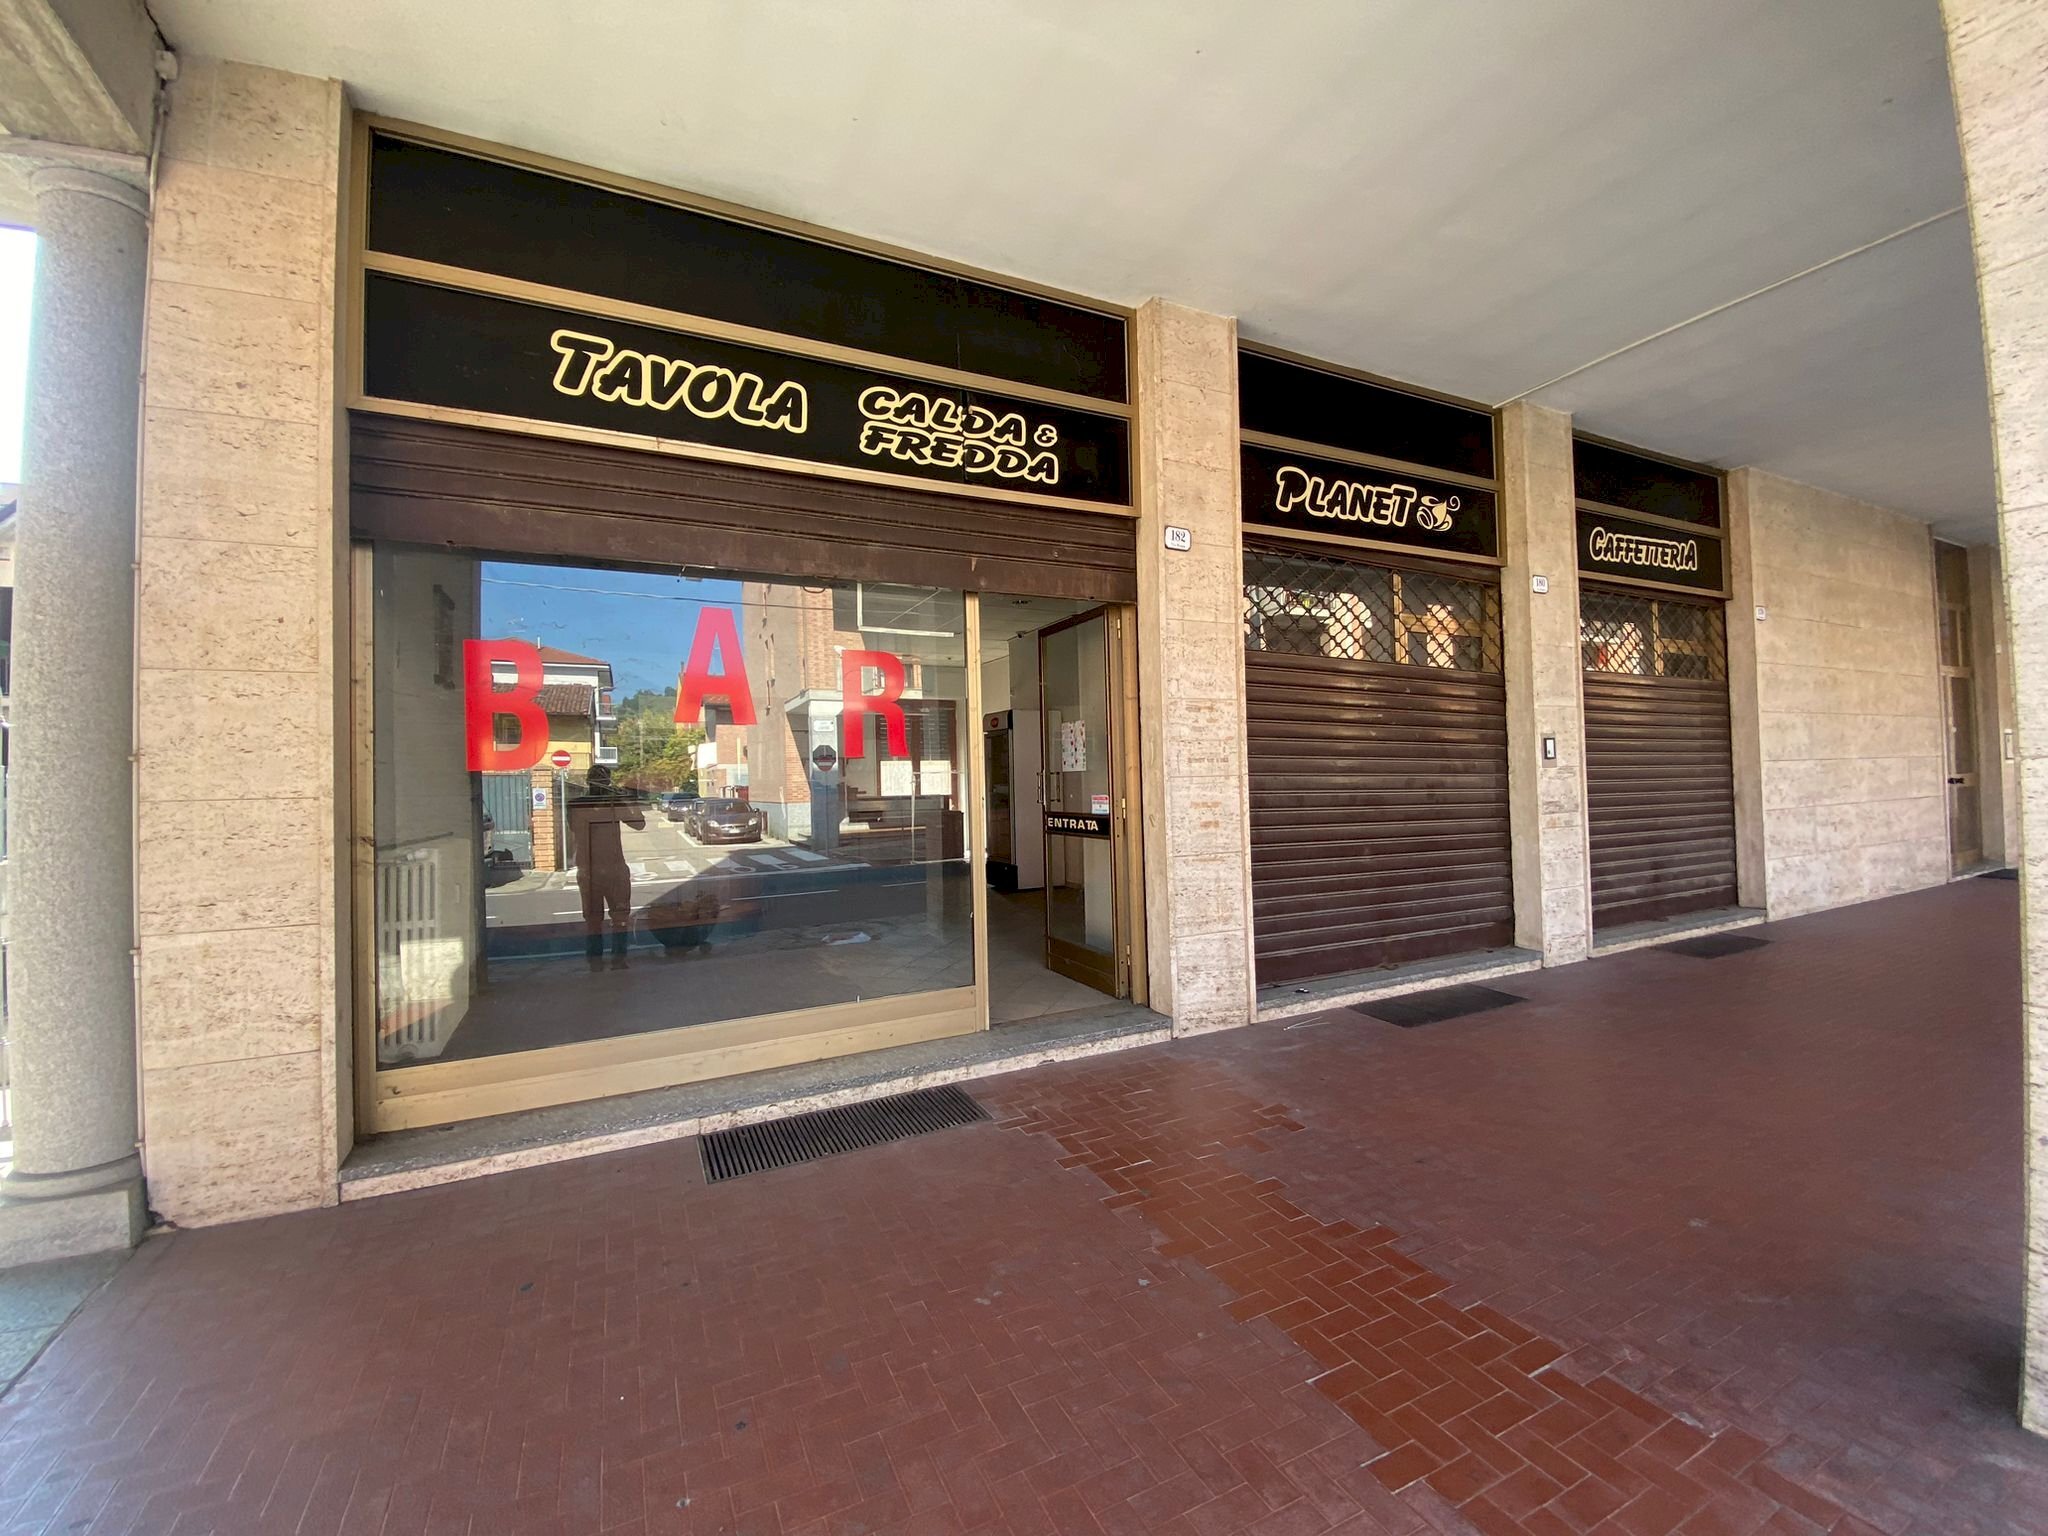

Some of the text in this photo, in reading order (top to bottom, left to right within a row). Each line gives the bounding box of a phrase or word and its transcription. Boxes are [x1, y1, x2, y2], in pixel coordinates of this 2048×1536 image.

[550, 329, 808, 433] TAVOLA
[858, 386, 1058, 447] CALDA &
[859, 420, 1059, 485] FREDDA
[1275, 465, 1418, 527] PLANET
[1171, 529, 1186, 543] 182
[1589, 526, 1698, 571] CAFFETTERIA
[1047, 817, 1099, 831] ENTRATA
